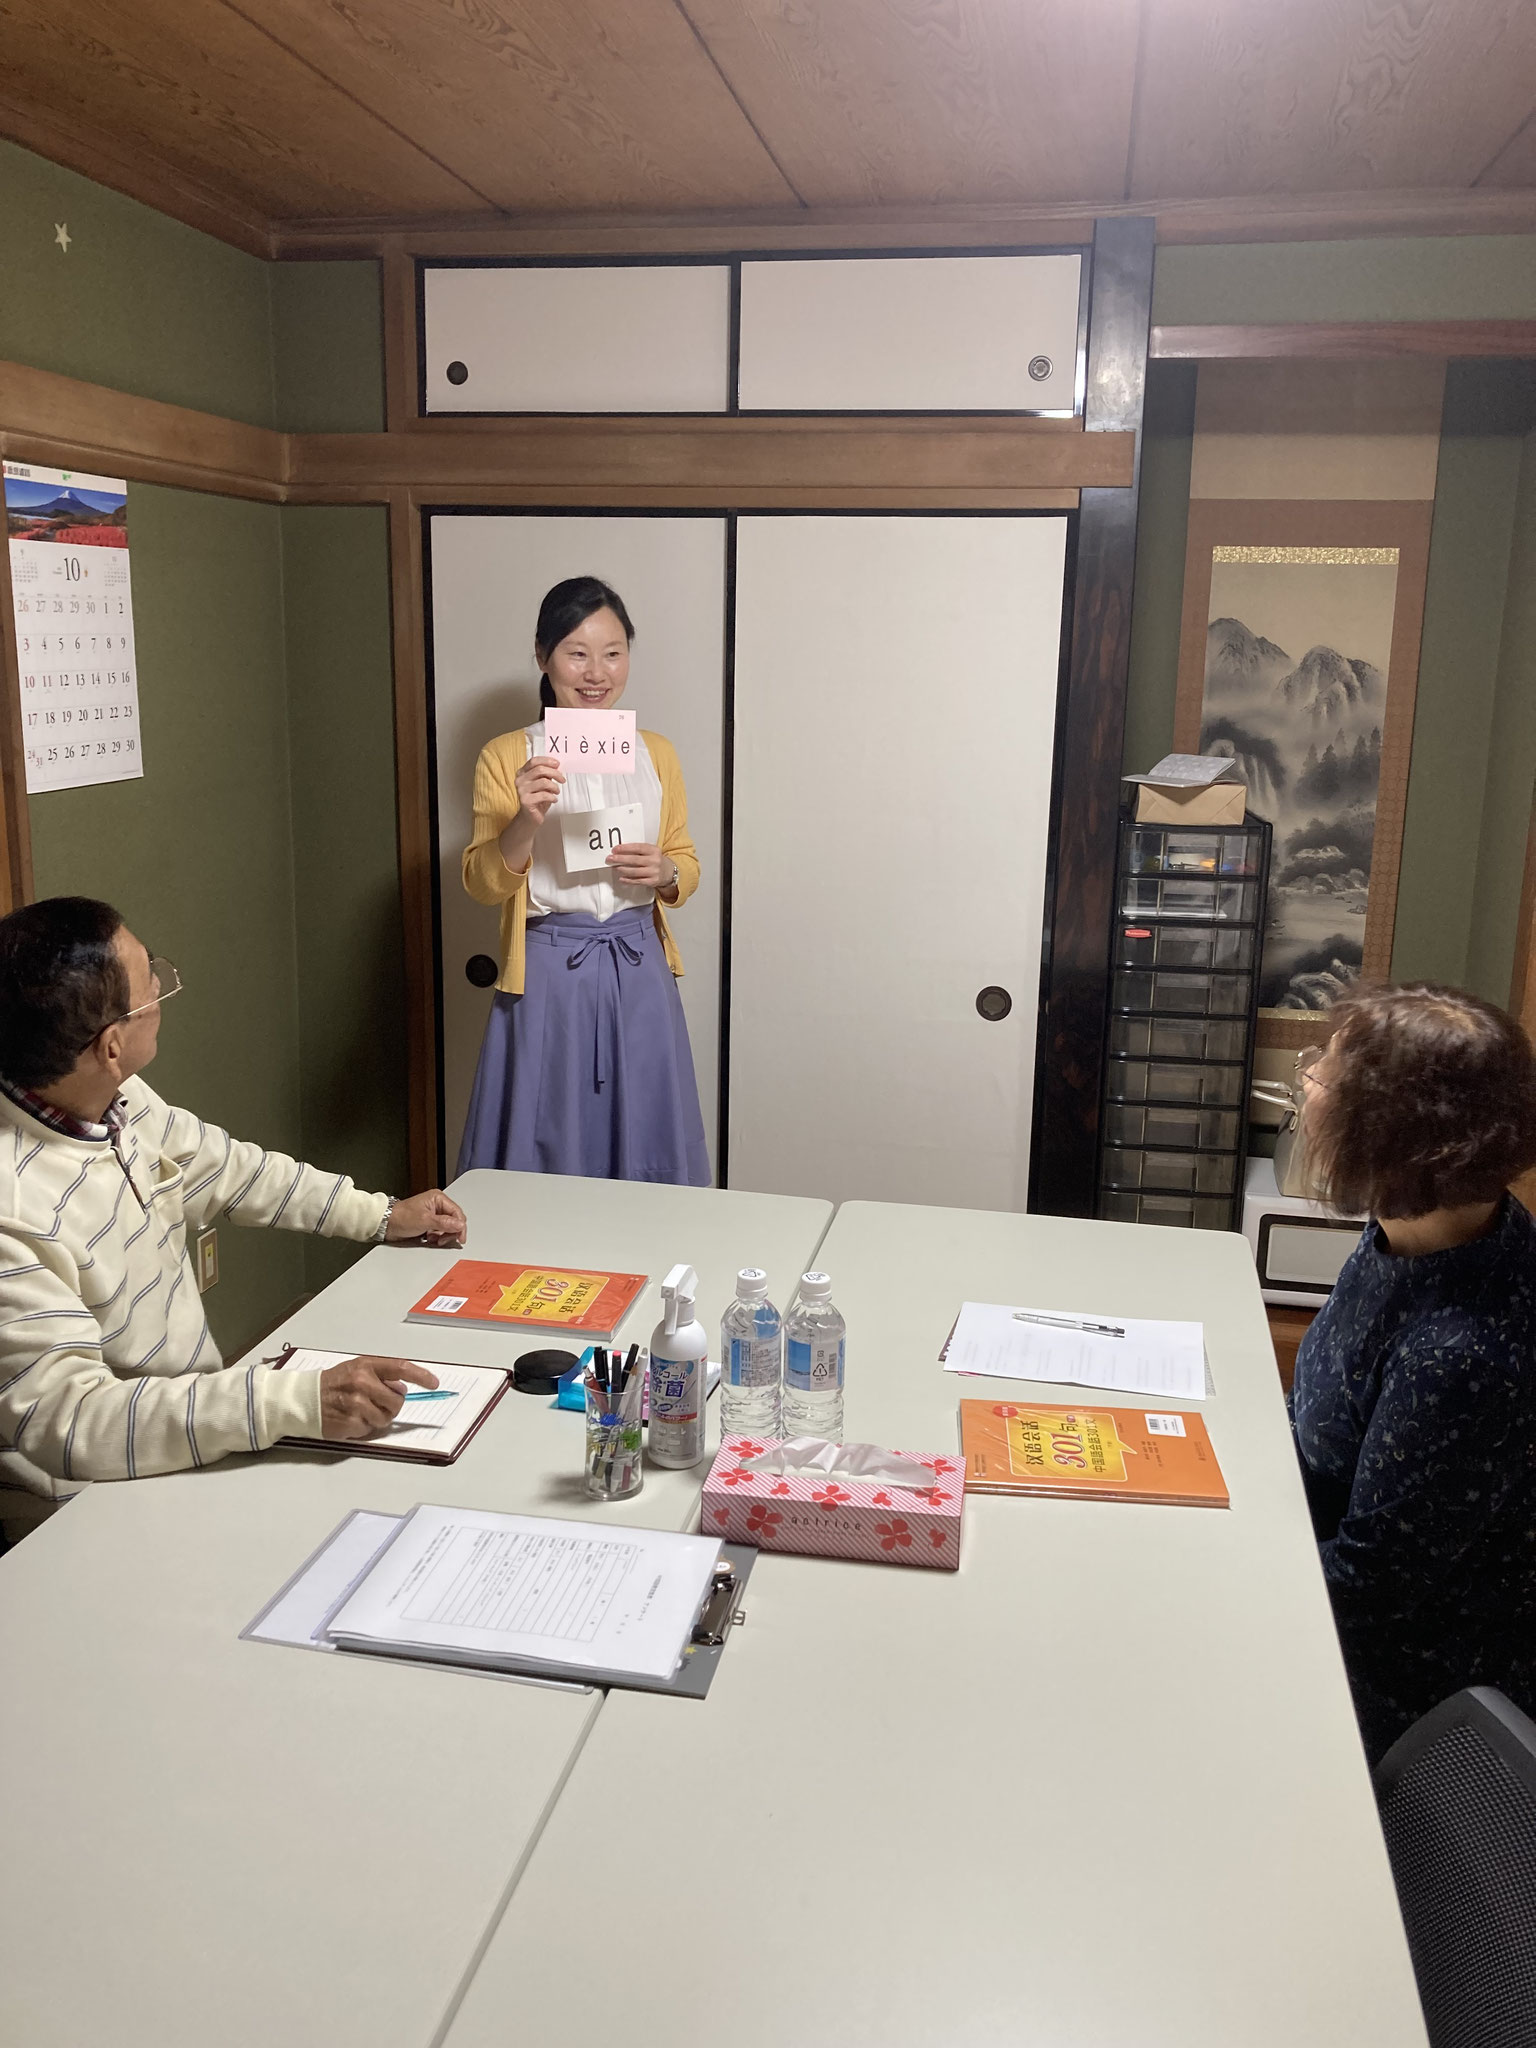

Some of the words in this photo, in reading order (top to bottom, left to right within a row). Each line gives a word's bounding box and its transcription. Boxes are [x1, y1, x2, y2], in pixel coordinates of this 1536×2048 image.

[64, 557, 81, 581] 10
[18, 599, 29, 613] 26
[36, 600, 46, 613] 27
[53, 600, 63, 613] 28
[70, 601, 80, 614] 29
[86, 602, 96, 614] 30
[104, 602, 108, 614] 1
[118, 602, 124, 614] 2
[23, 637, 30, 651] 3
[41, 637, 47, 650] 4
[58, 637, 64, 650] 5
[74, 636, 81, 650] 6
[91, 637, 96, 650] 7
[106, 637, 112, 649] 8
[121, 636, 126, 649] 9
[24, 675, 35, 689] 10
[42, 675, 52, 688] 11
[59, 674, 69, 687] 12
[75, 673, 85, 686] 13
[91, 672, 101, 685] 14
[107, 672, 116, 684] 15
[121, 671, 130, 684] 16
[28, 713, 38, 726] 17
[45, 712, 56, 725] 18
[62, 710, 72, 723] 19
[78, 709, 88, 721] 20
[94, 708, 103, 720] 21
[109, 706, 119, 719] 22
[123, 705, 133, 718] 23
[27, 749, 36, 760] 24
[47, 748, 58, 761] 25
[64, 746, 75, 759] 26
[80, 744, 90, 757] 27
[96, 742, 106, 755] 28
[112, 741, 121, 753] 29
[125, 739, 135, 752] 30
[36, 757, 43, 767] 31
[588, 826, 623, 850] an
[1020, 1420, 1044, 1465] 汉语会话
